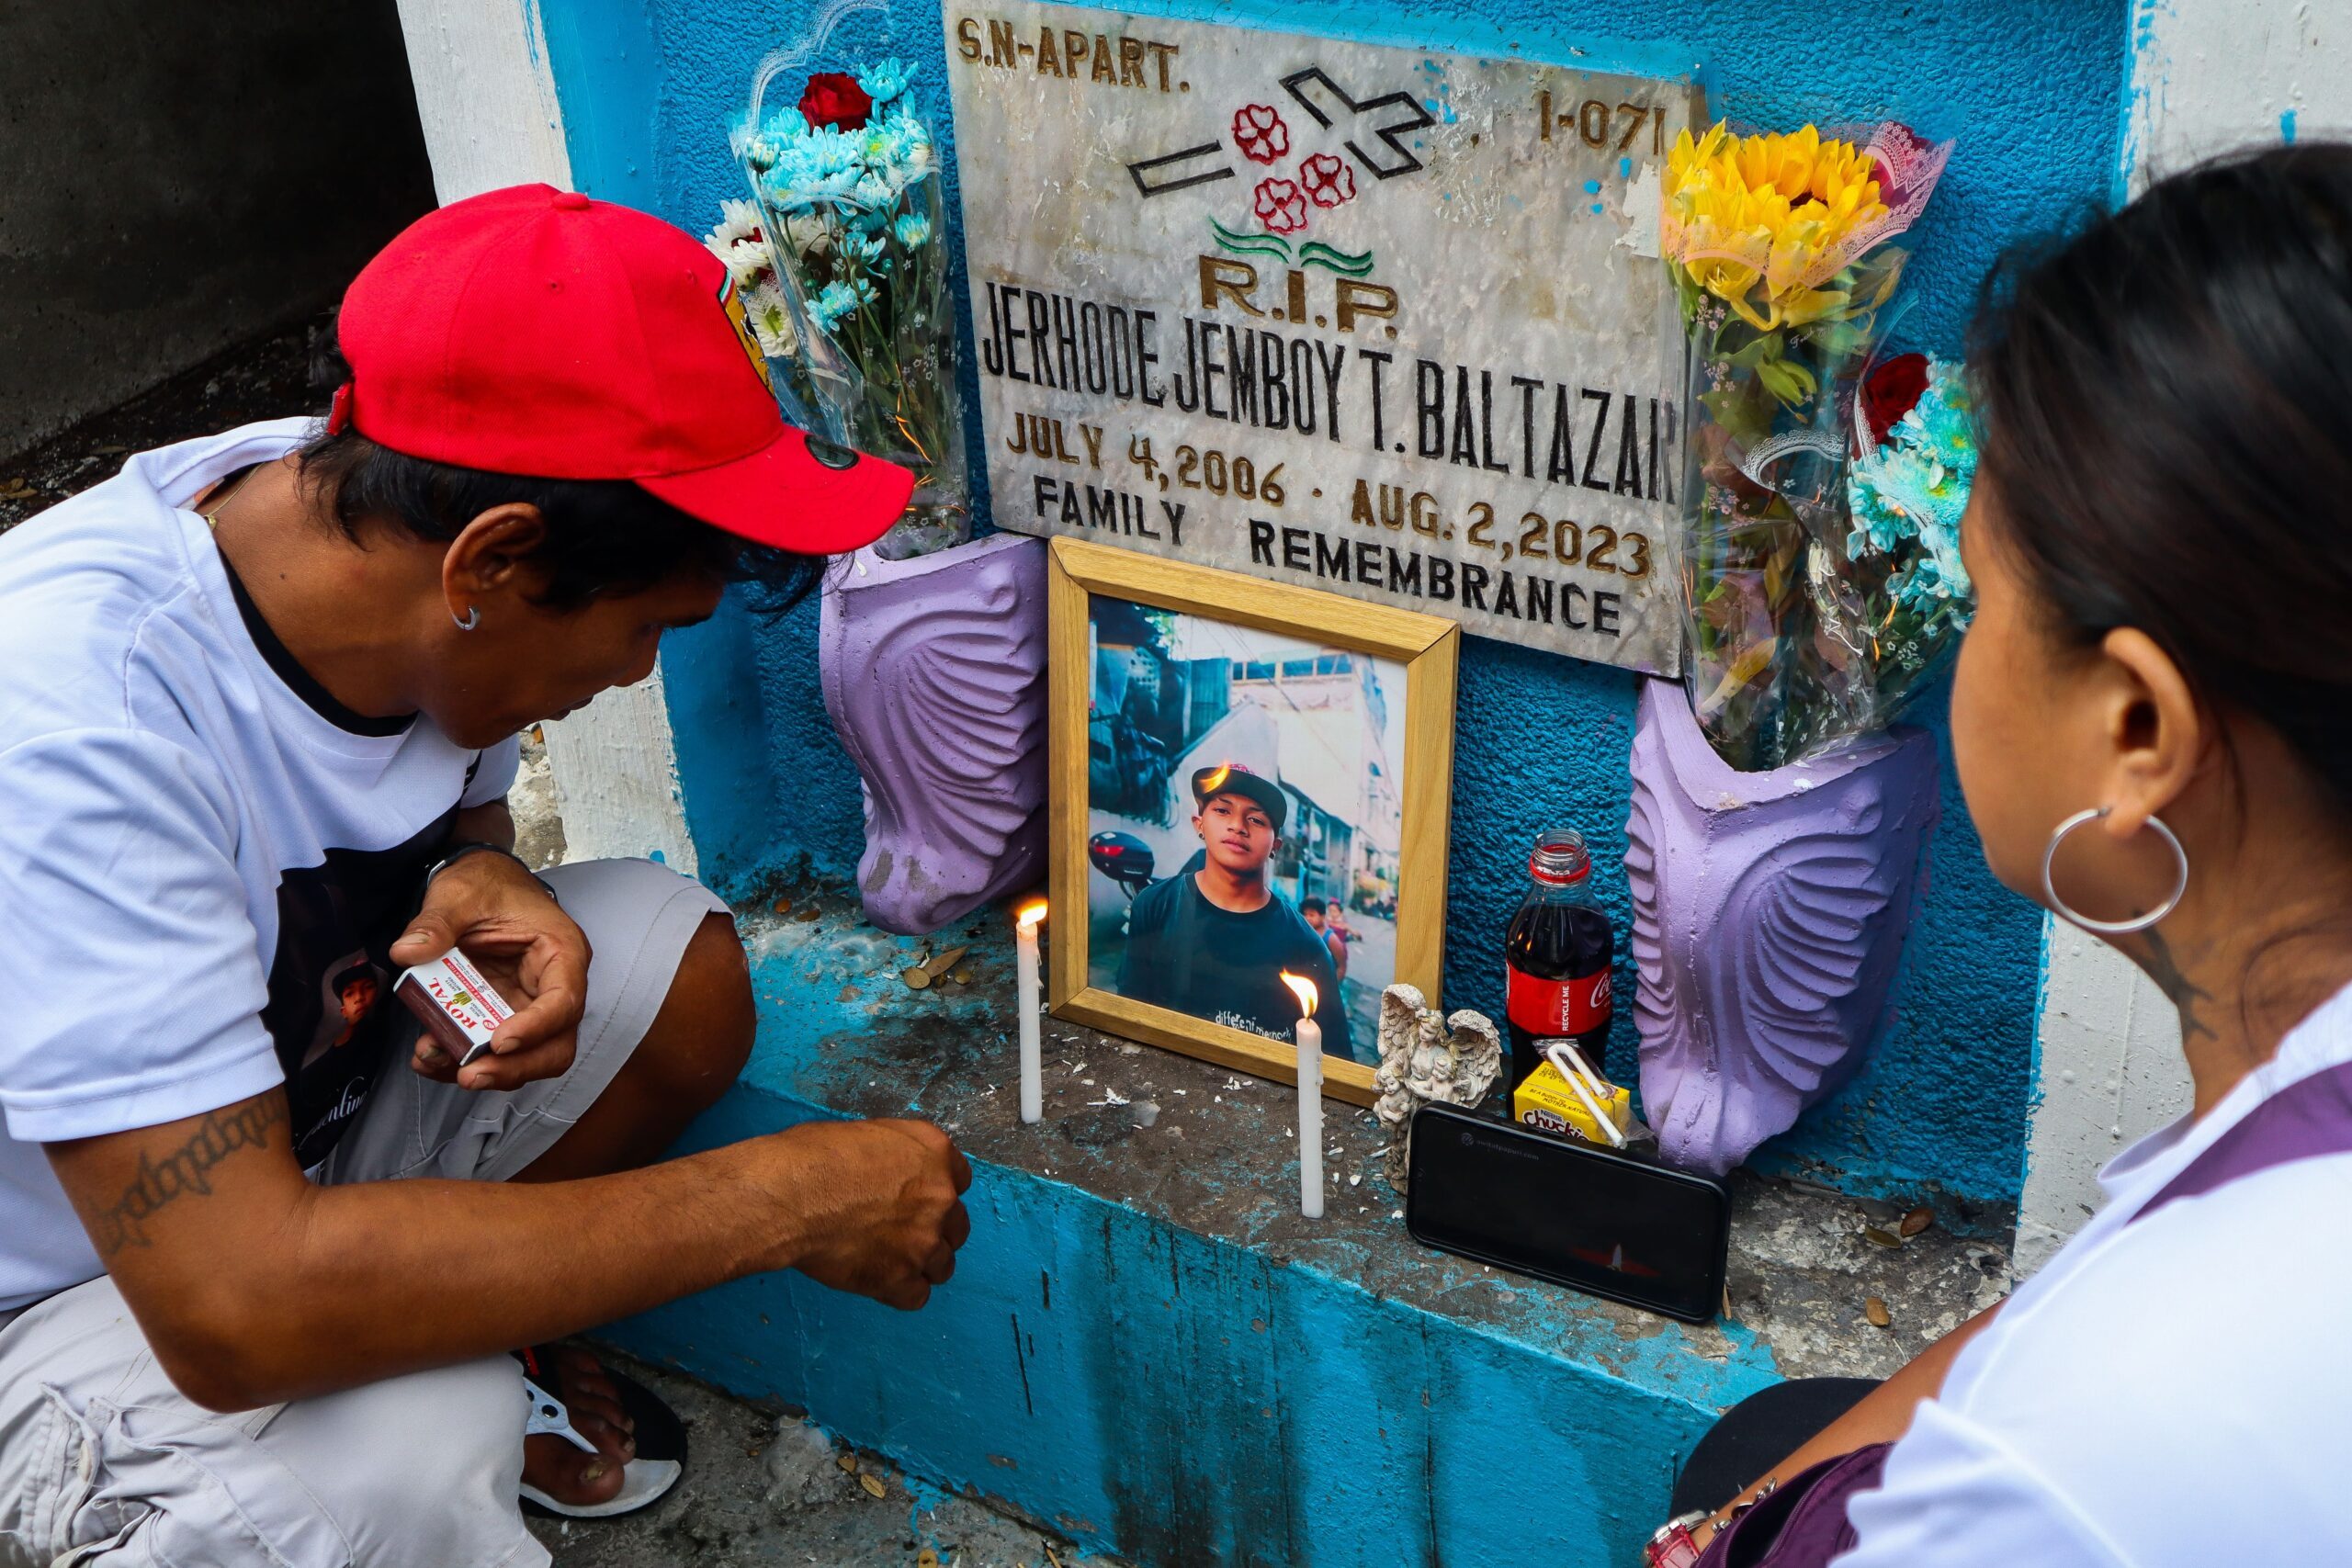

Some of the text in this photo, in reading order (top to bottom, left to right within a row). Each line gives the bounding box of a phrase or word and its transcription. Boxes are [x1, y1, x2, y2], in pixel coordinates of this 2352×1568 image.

[1198, 254, 1398, 339] R.I.P.
[981, 281, 1164, 409] JERHODE
[1173, 316, 1346, 443] JEMBOY
[1007, 412, 1103, 469] JULY
[1128, 434, 1284, 507] 4,2006
[1034, 474, 1621, 637] FAMILY REMEMBRANCE
[429, 977, 478, 1029] ROYAL
[1562, 986, 1569, 998] ME
[1543, 1098, 1566, 1108] MOTHER
